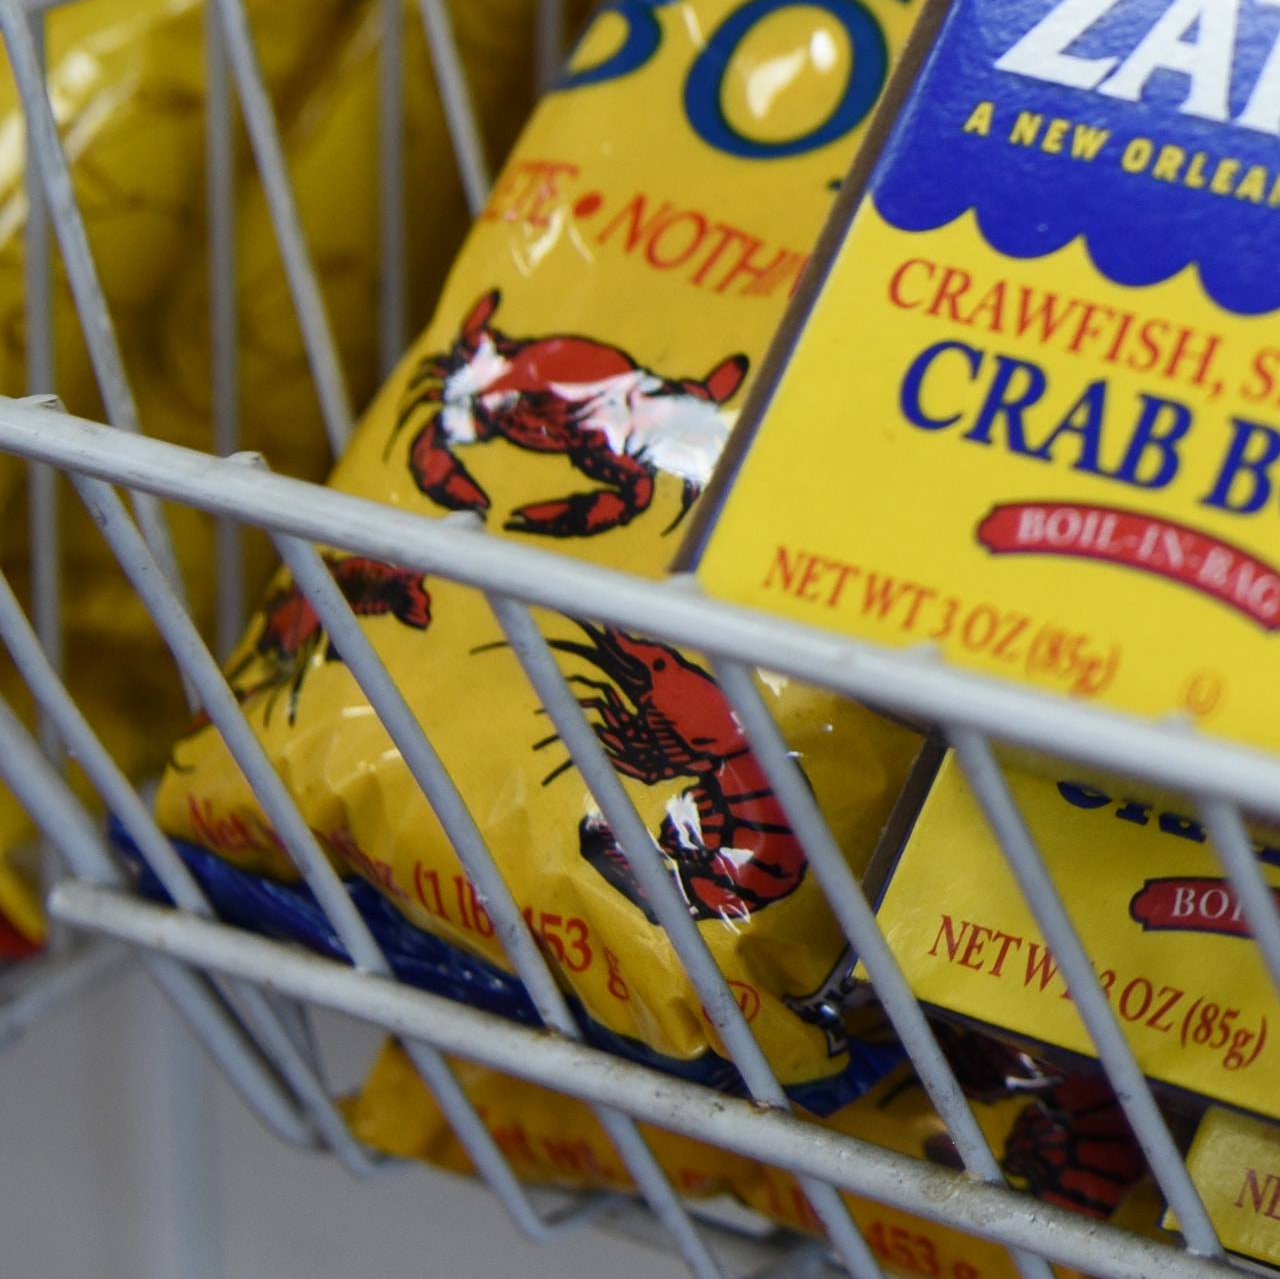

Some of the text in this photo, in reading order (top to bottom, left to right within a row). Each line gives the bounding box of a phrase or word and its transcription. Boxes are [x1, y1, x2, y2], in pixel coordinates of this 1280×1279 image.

[963, 101, 995, 135] A
[1008, 109, 1110, 161] NEW
[886, 256, 1227, 400] CRAWFISH,
[899, 339, 1194, 492] CRAB
[763, 545, 859, 608] NET
[861, 572, 936, 630] WT
[961, 603, 1031, 662] OZ
[928, 914, 1023, 978] NET
[1118, 977, 1184, 1033] OZ
[1180, 996, 1267, 1071] (85g)
